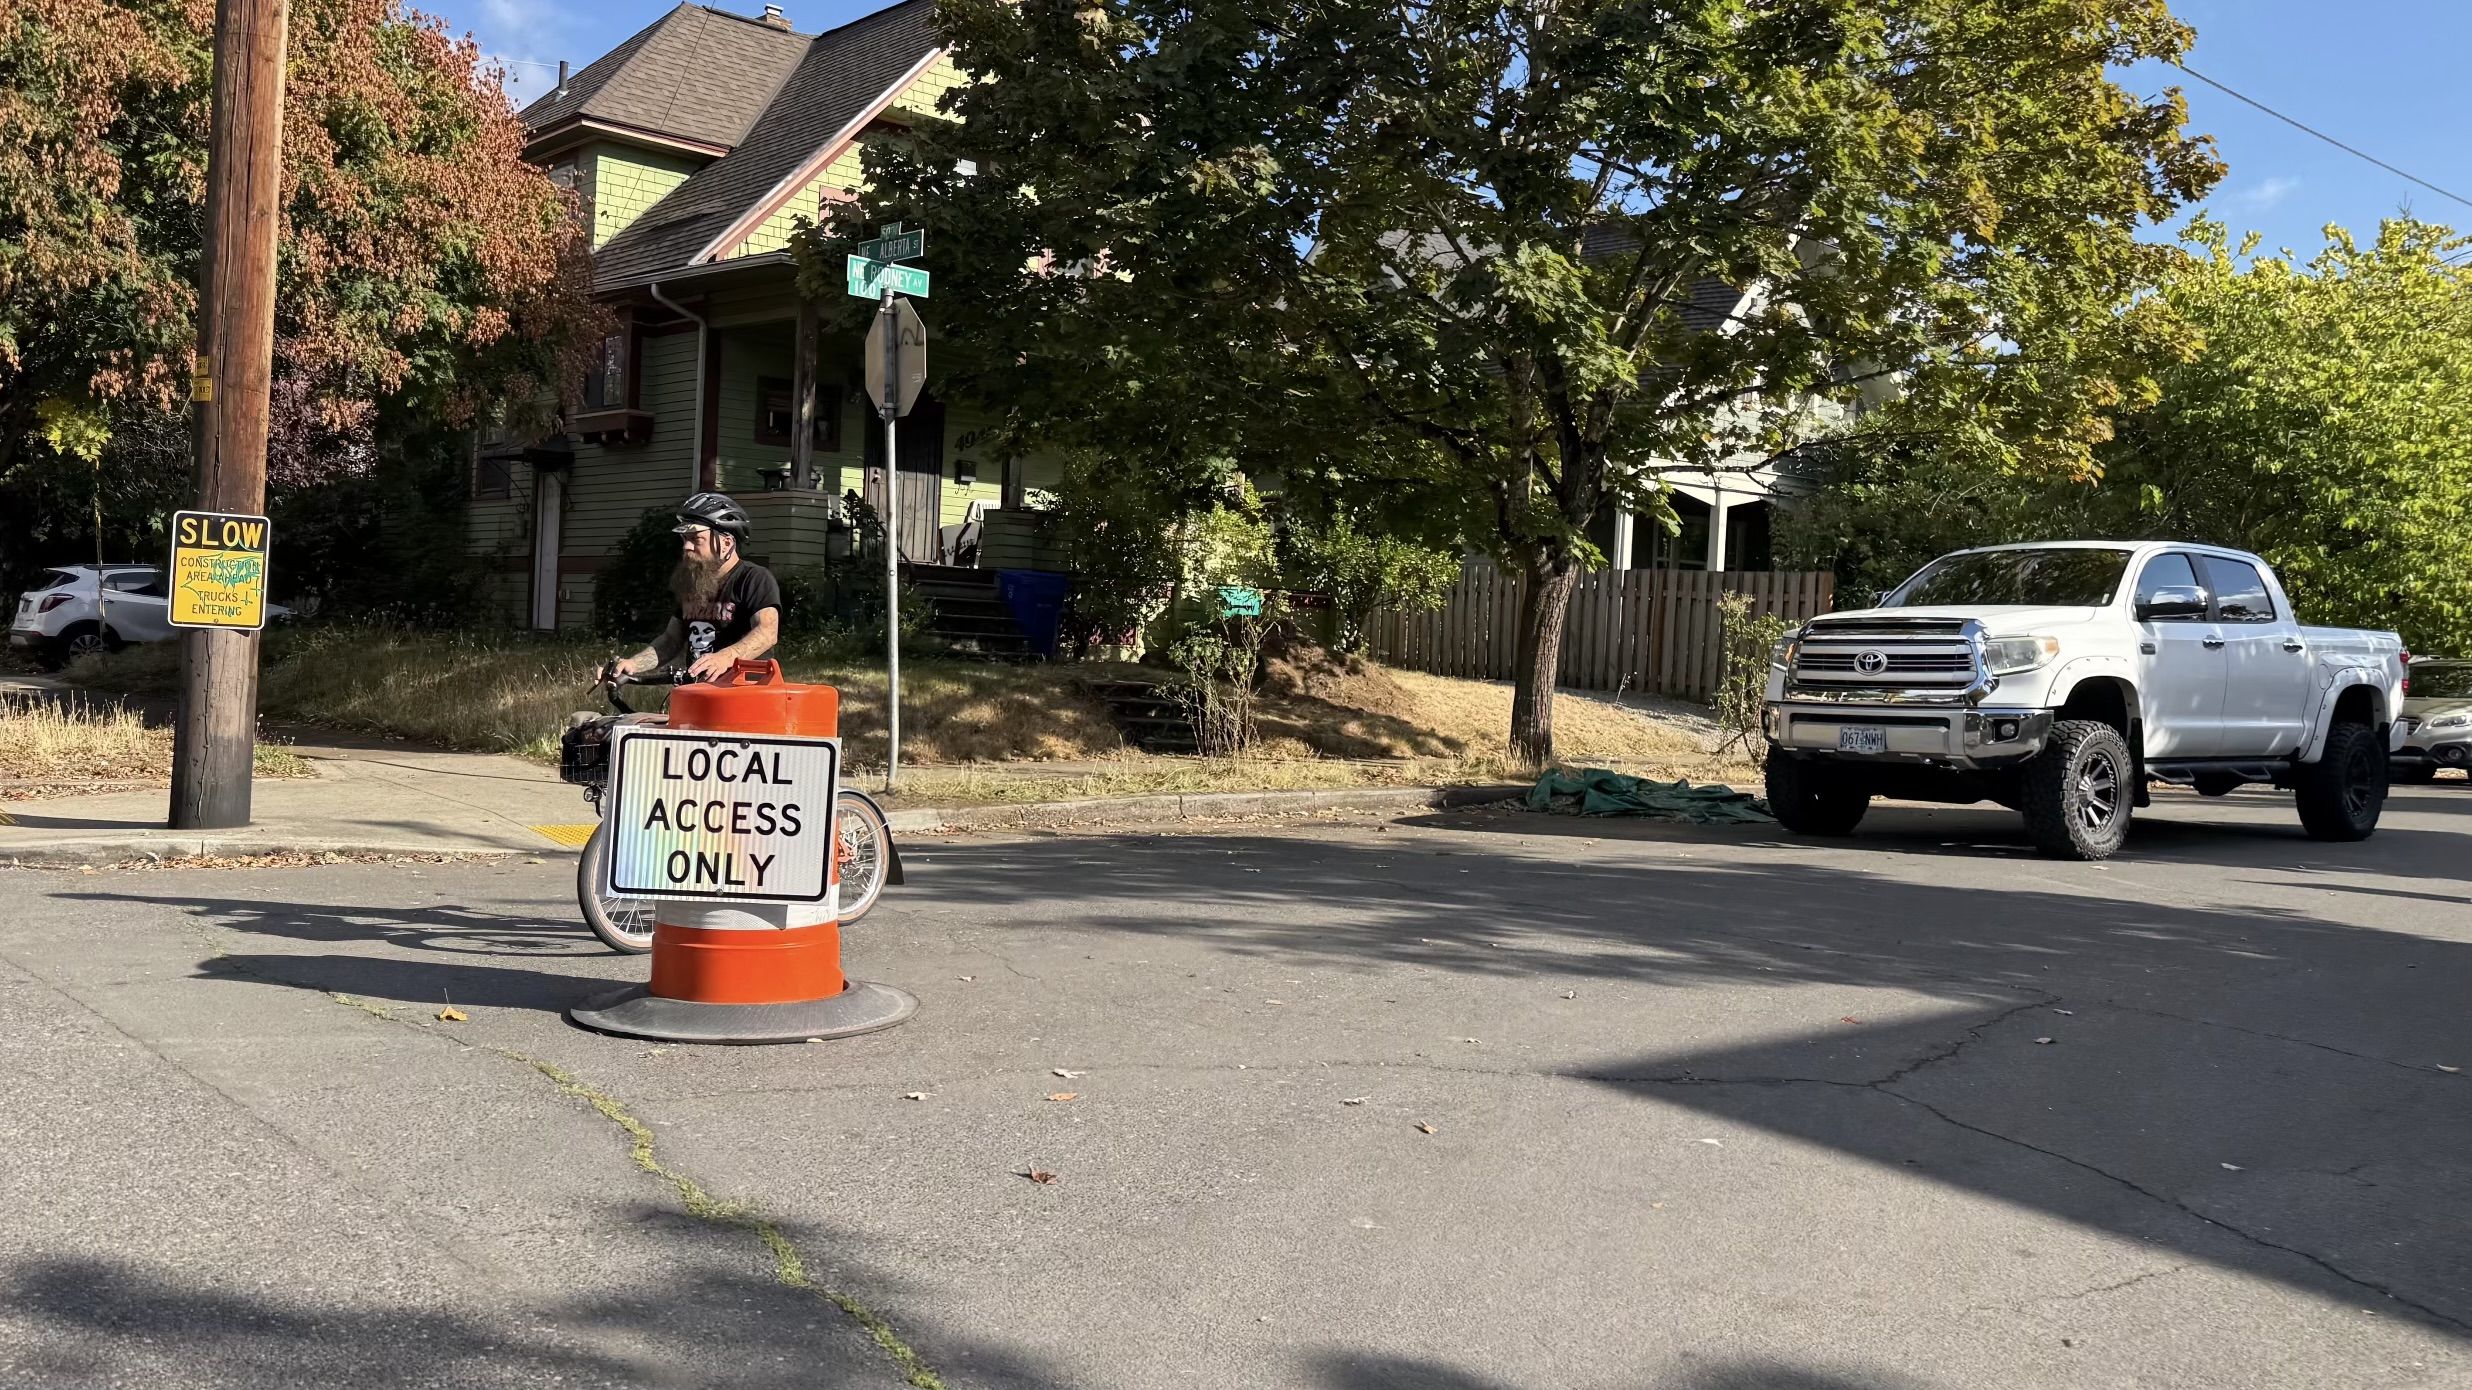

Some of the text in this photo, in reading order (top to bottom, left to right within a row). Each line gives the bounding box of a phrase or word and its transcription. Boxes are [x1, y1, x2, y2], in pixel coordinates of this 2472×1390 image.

[861, 246, 870, 258] NE
[880, 238, 910, 259] ALBERTA
[853, 260, 923, 289] NE RODNEY AV
[854, 281, 877, 298] 100
[180, 517, 264, 549] SLOW
[186, 571, 213, 582] AREA
[198, 590, 239, 602] TRUCKS
[192, 604, 242, 616] ENTERING
[1842, 731, 1860, 746] 067
[662, 747, 793, 785] LOCAL
[644, 798, 802, 837] ACCESS
[667, 850, 776, 887] ONLY
